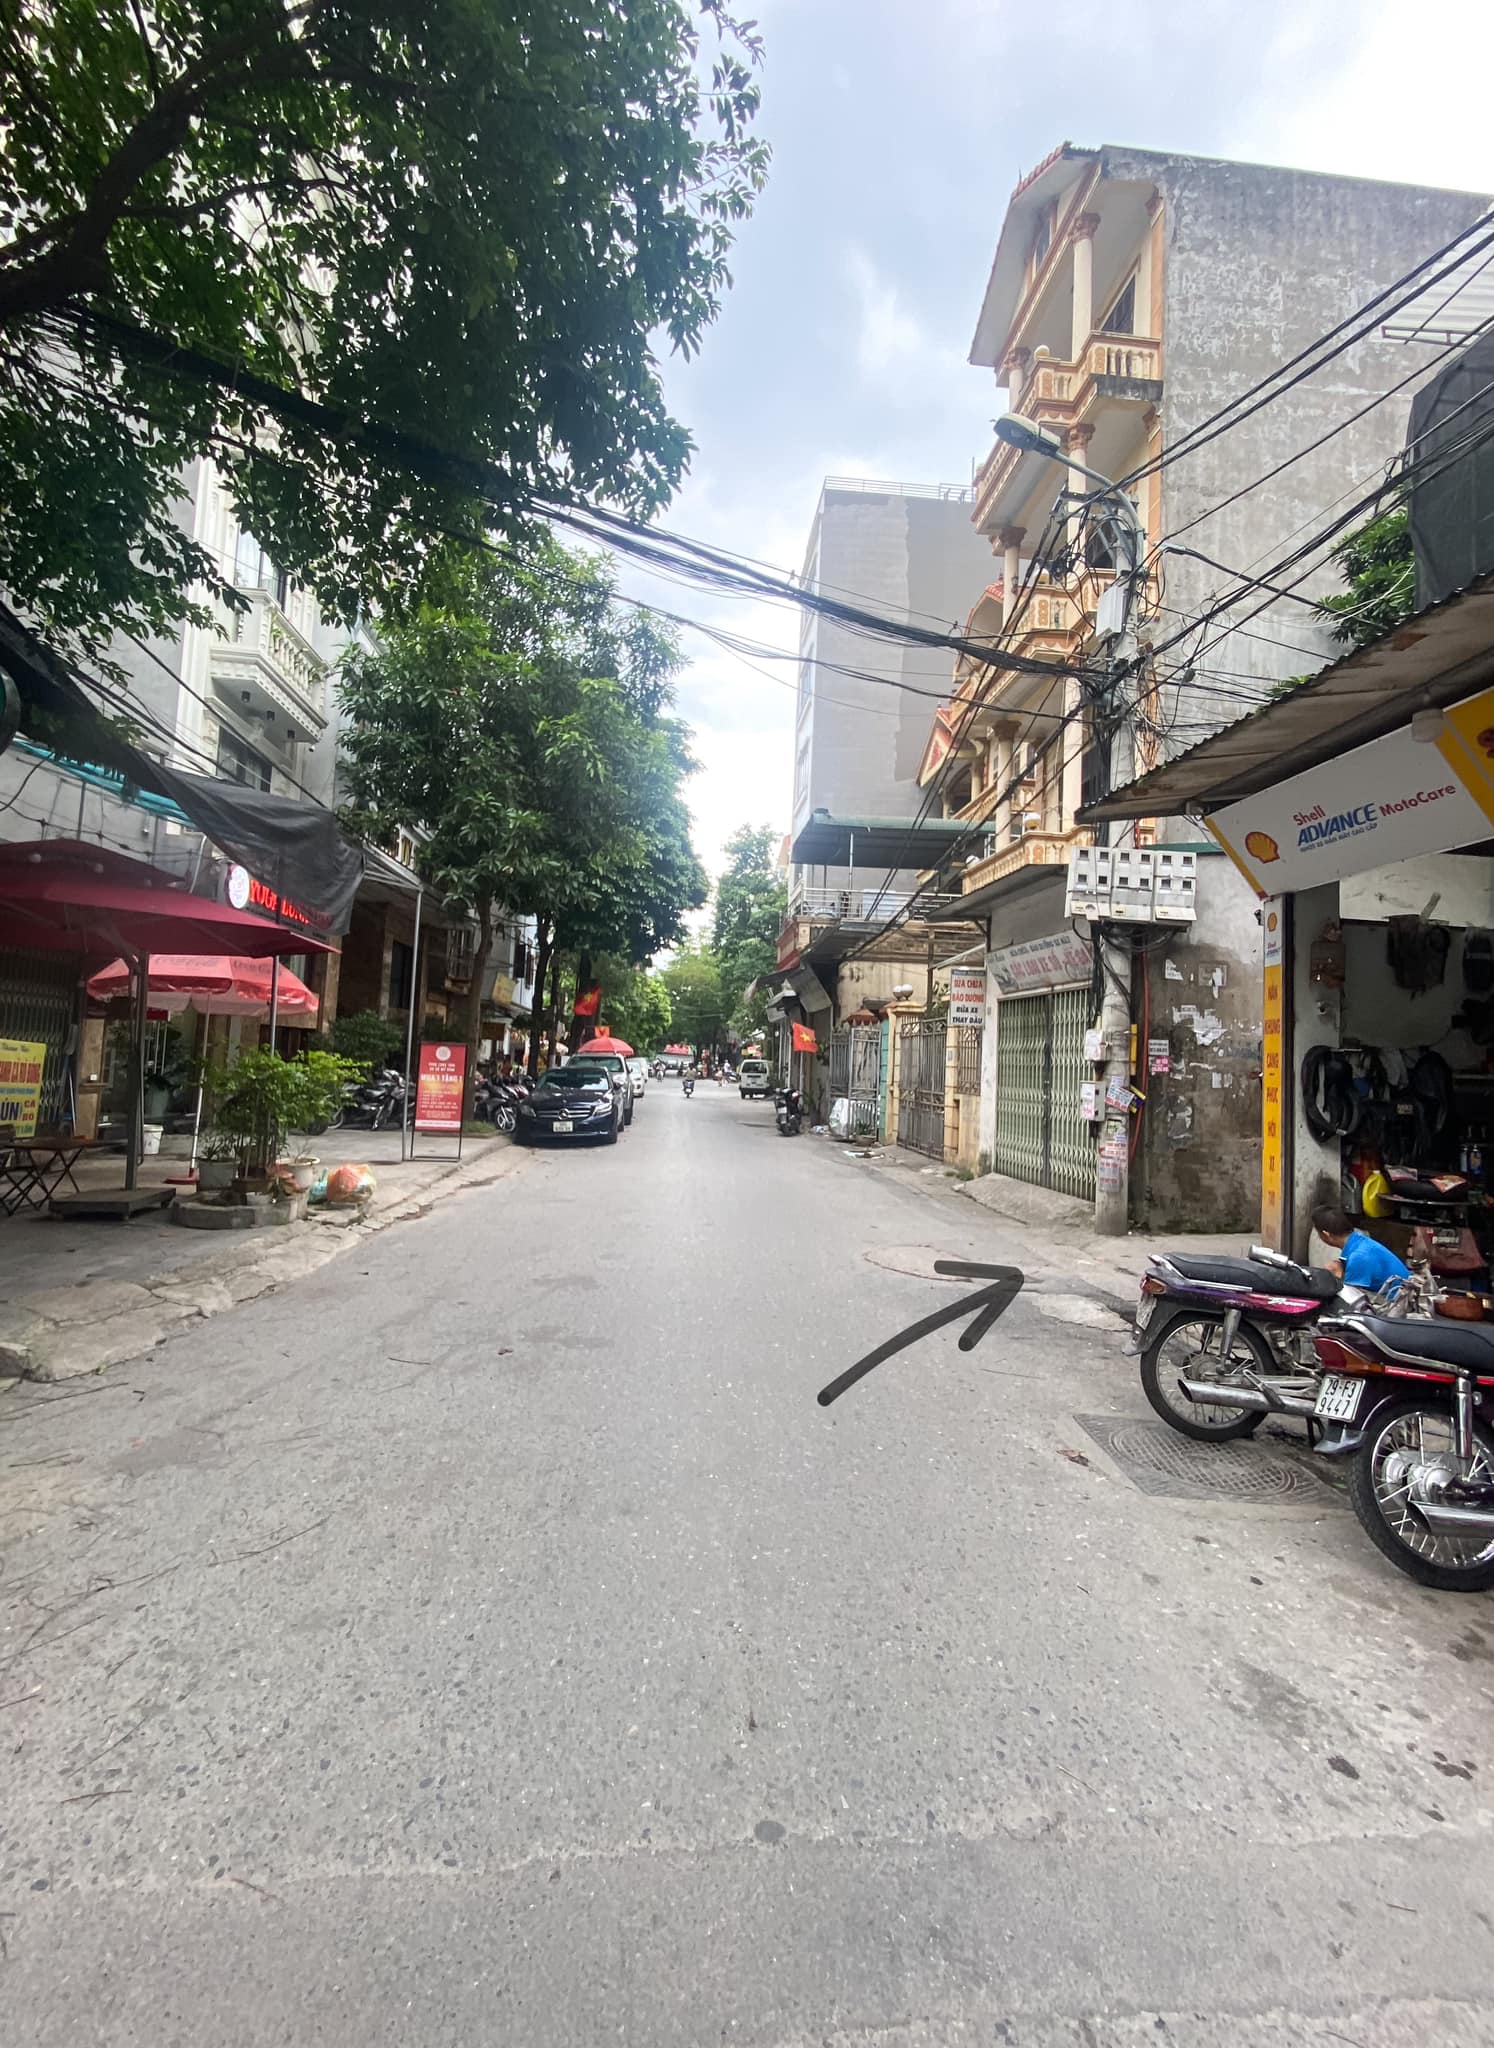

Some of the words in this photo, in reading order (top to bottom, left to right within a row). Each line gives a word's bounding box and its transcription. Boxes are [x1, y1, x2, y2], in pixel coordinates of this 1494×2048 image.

[1293, 804, 1326, 826] Shell
[1297, 802, 1378, 847] ADVANCE
[1379, 785, 1456, 817] MotoCare
[1325, 1379, 1356, 1398] 29-F3
[1319, 1397, 1350, 1416] 9447
